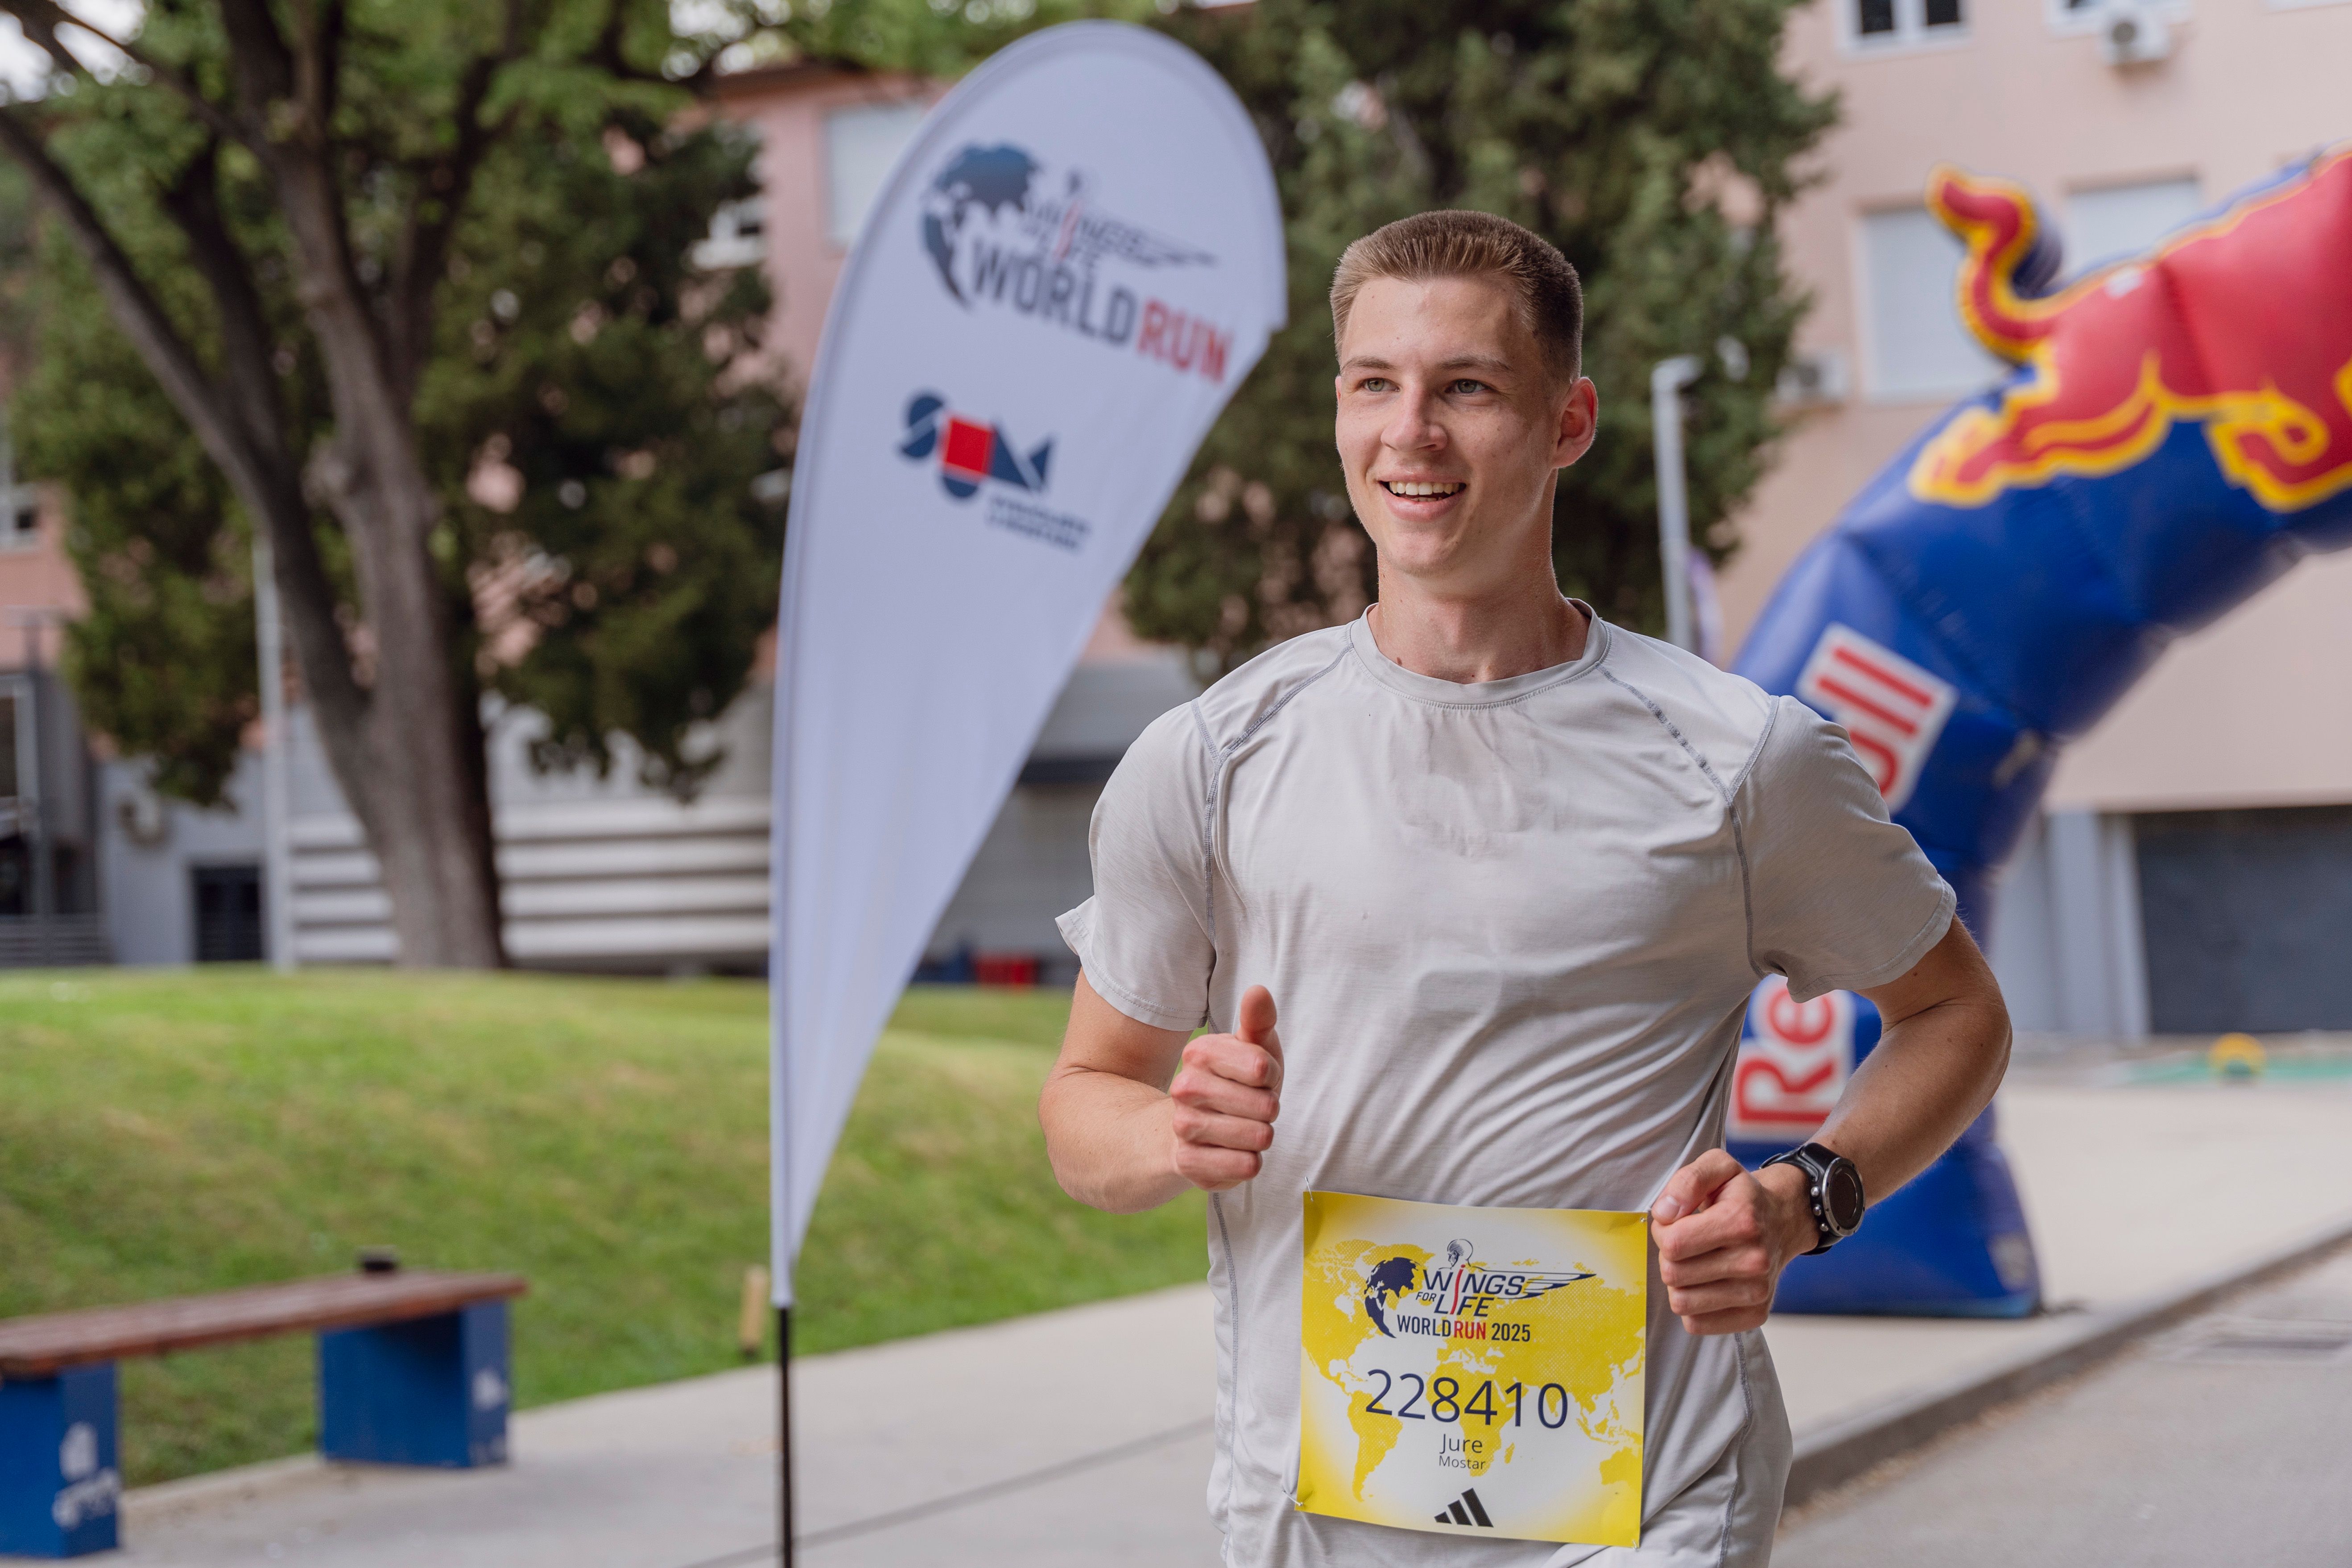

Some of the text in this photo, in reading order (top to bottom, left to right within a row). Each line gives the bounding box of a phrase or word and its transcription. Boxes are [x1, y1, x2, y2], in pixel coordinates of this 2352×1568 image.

[973, 239, 1233, 385] WORLD RUN
[1735, 644, 1934, 1124] Re ull
[1423, 1264, 1526, 1296] WINGS
[1415, 1291, 1494, 1317] FOR LIFE
[1397, 1314, 1530, 1342] WORLD RUN 2025
[1365, 1369, 1568, 1429] 228410
[1439, 1433, 1483, 1455] Jure
[1439, 1455, 1486, 1470] Mostar
